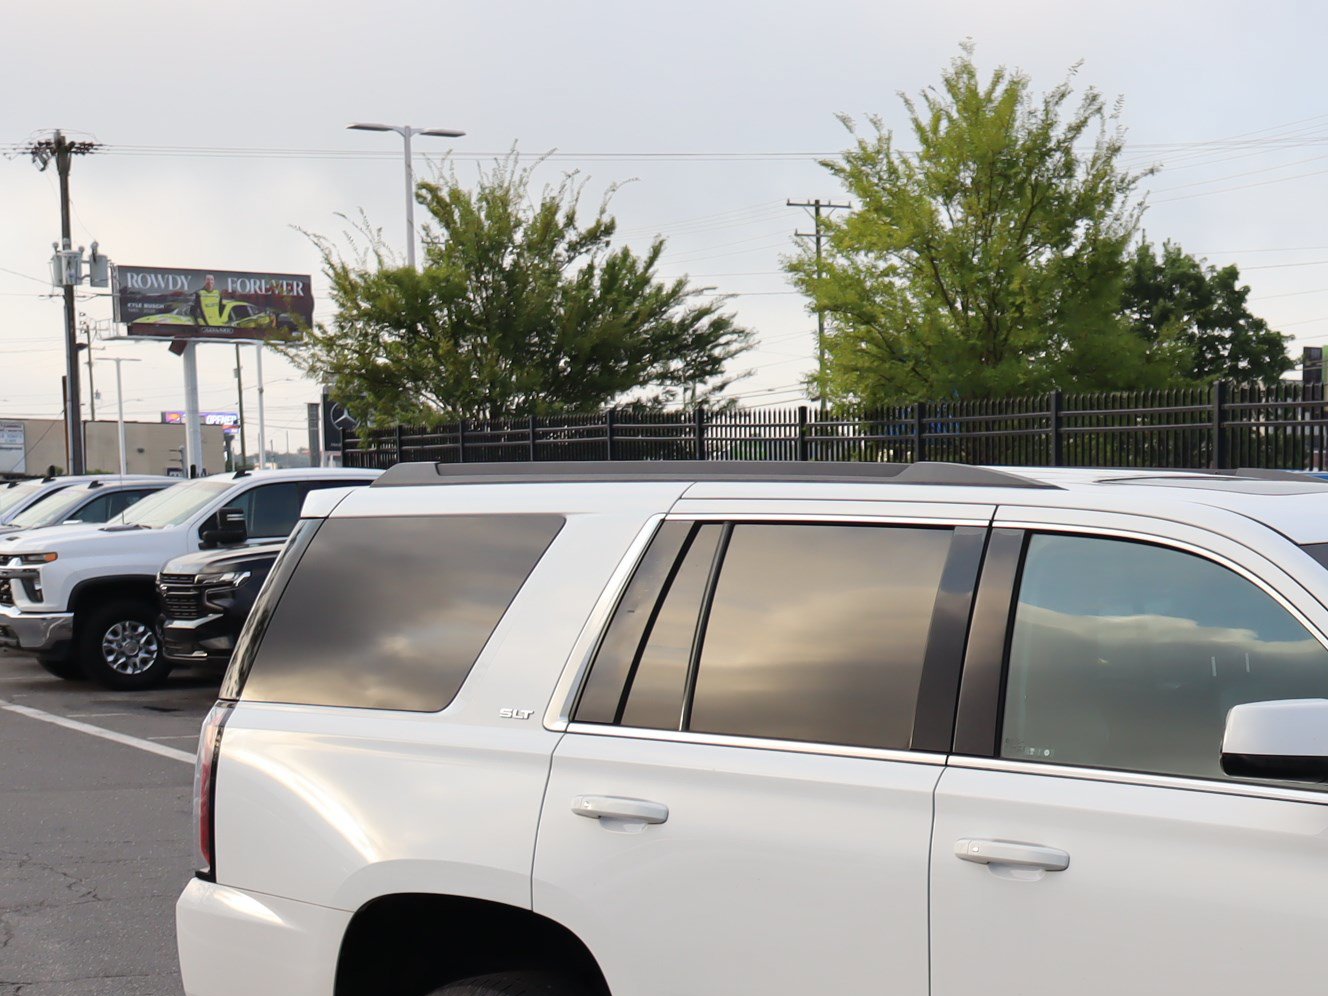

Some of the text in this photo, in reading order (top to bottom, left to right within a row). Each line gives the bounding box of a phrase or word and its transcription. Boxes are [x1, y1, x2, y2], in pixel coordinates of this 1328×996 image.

[127, 272, 304, 297] ROWDY FOREVER
[499, 708, 535, 720] SLT
